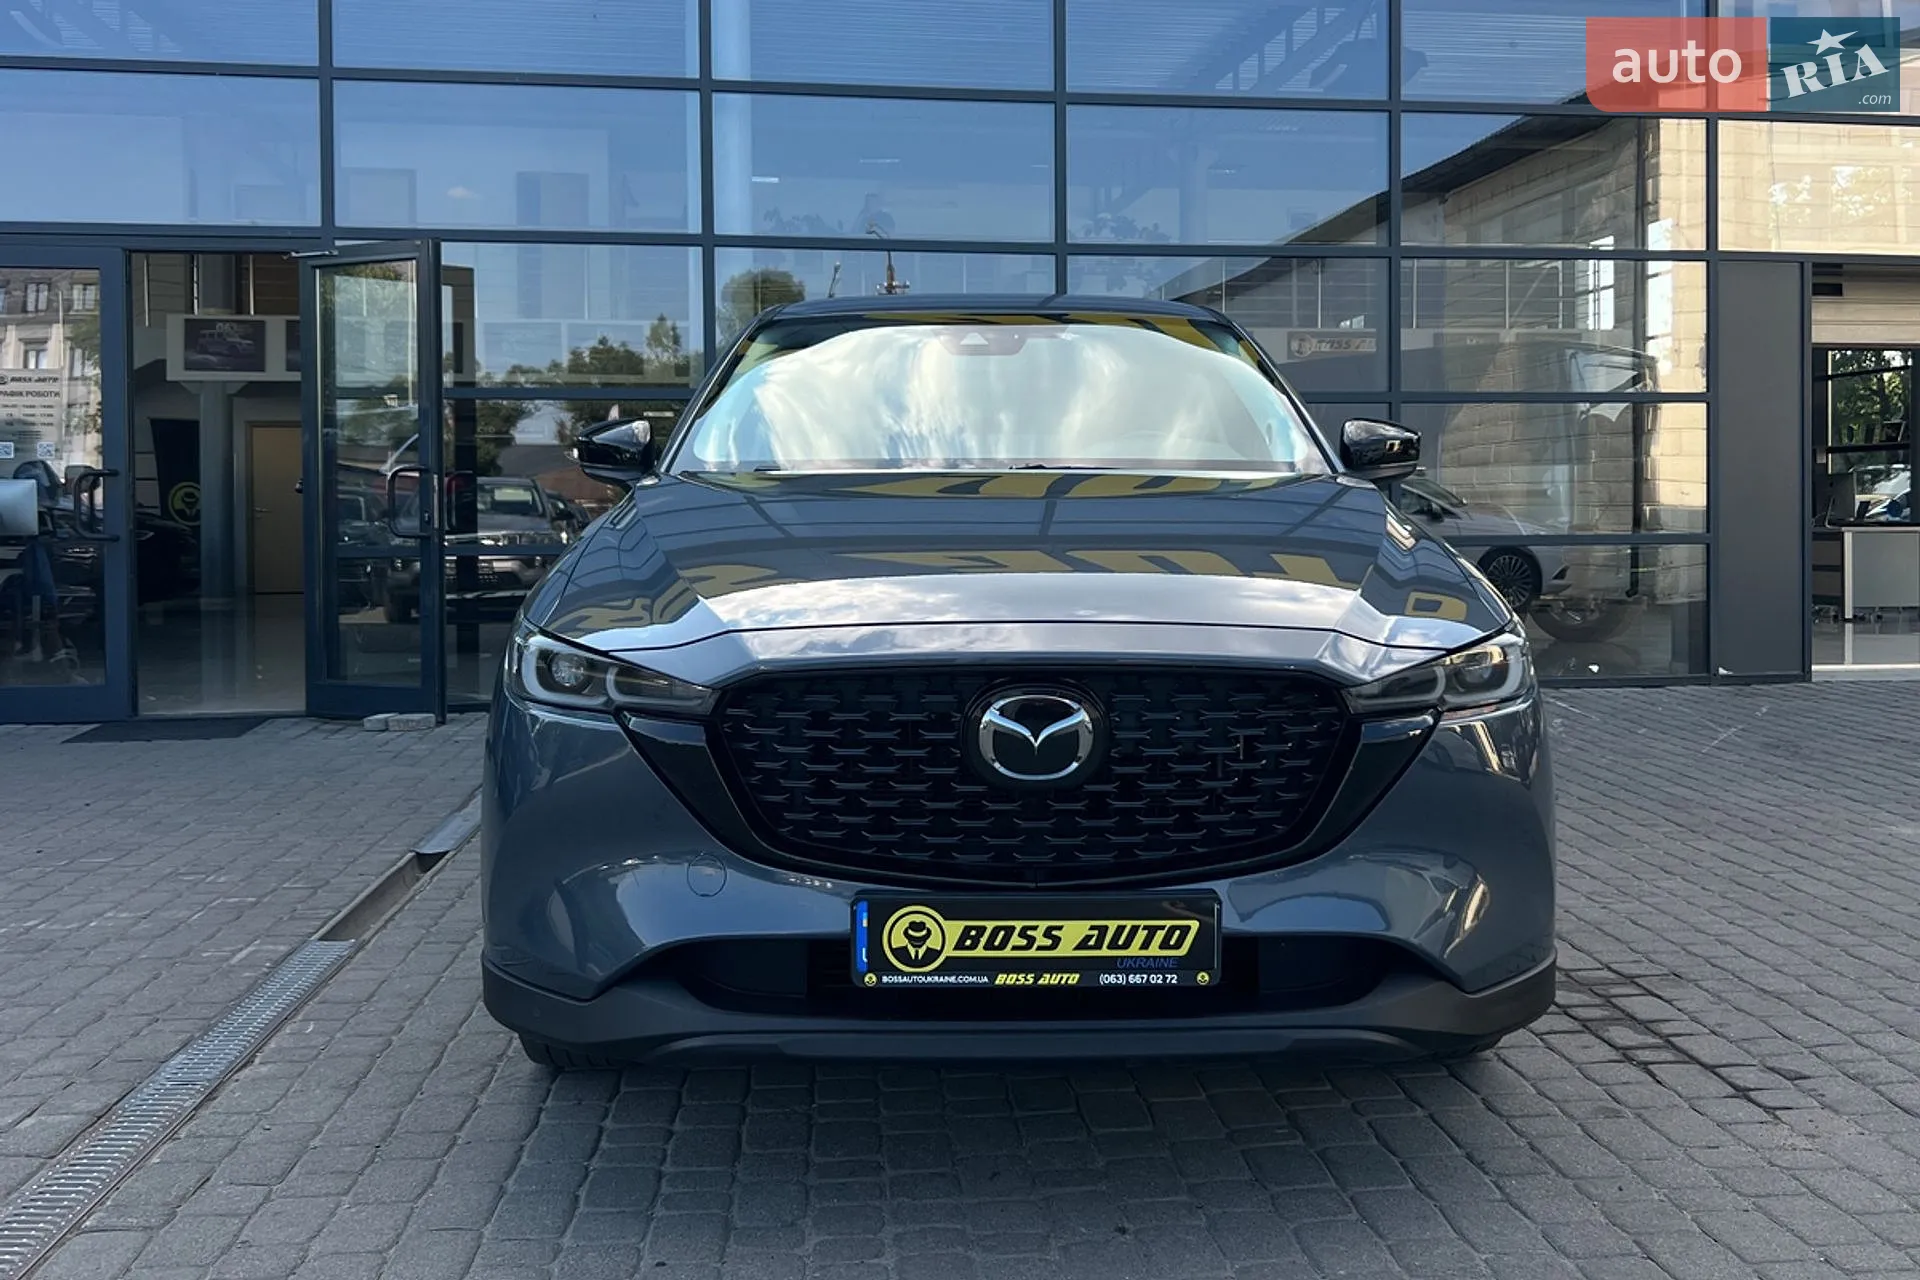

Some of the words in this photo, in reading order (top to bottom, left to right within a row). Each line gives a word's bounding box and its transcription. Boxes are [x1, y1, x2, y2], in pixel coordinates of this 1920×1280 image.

[952, 925, 1064, 951] BOSS
[1072, 925, 1192, 951] AUTO
[1116, 957, 1179, 968] UKRAINE
[881, 975, 989, 984] BOSSAUTOUKRAINE.COM.UA
[994, 973, 1035, 985] BOSS
[1037, 973, 1081, 985] AUTO
[1099, 974, 1127, 985] (063)
[1128, 974, 1147, 984] 667
[1149, 974, 1164, 984] 02
[1166, 974, 1178, 984] 72
